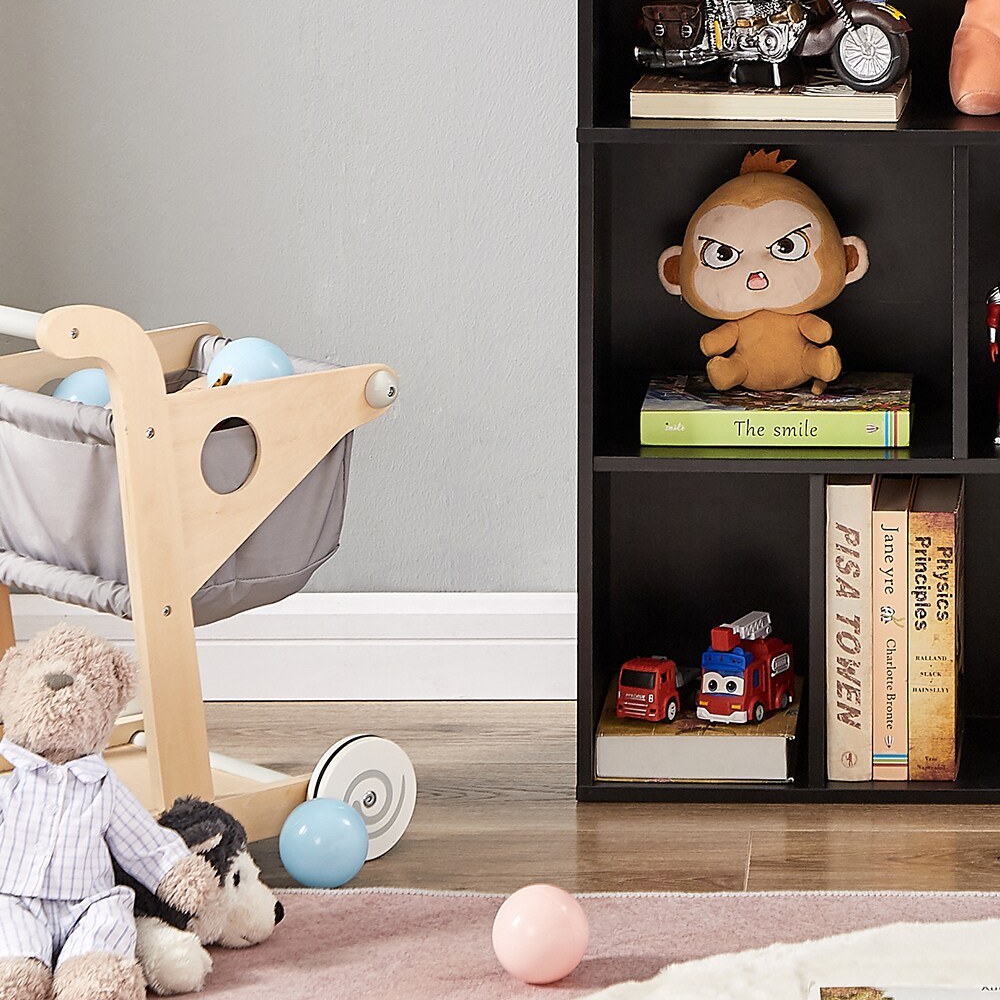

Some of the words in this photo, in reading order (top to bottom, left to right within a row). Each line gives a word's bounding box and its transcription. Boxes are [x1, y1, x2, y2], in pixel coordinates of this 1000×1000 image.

[733, 419, 765, 437] The
[773, 419, 818, 437] smile
[835, 522, 861, 599] PISA
[880, 524, 900, 563] Jane
[879, 567, 894, 595] yre
[911, 536, 932, 631] Principles
[932, 546, 954, 622] Physics
[835, 613, 862, 730] TOWEN
[885, 638, 897, 691] Charlotte
[885, 693, 897, 730] Bronte
